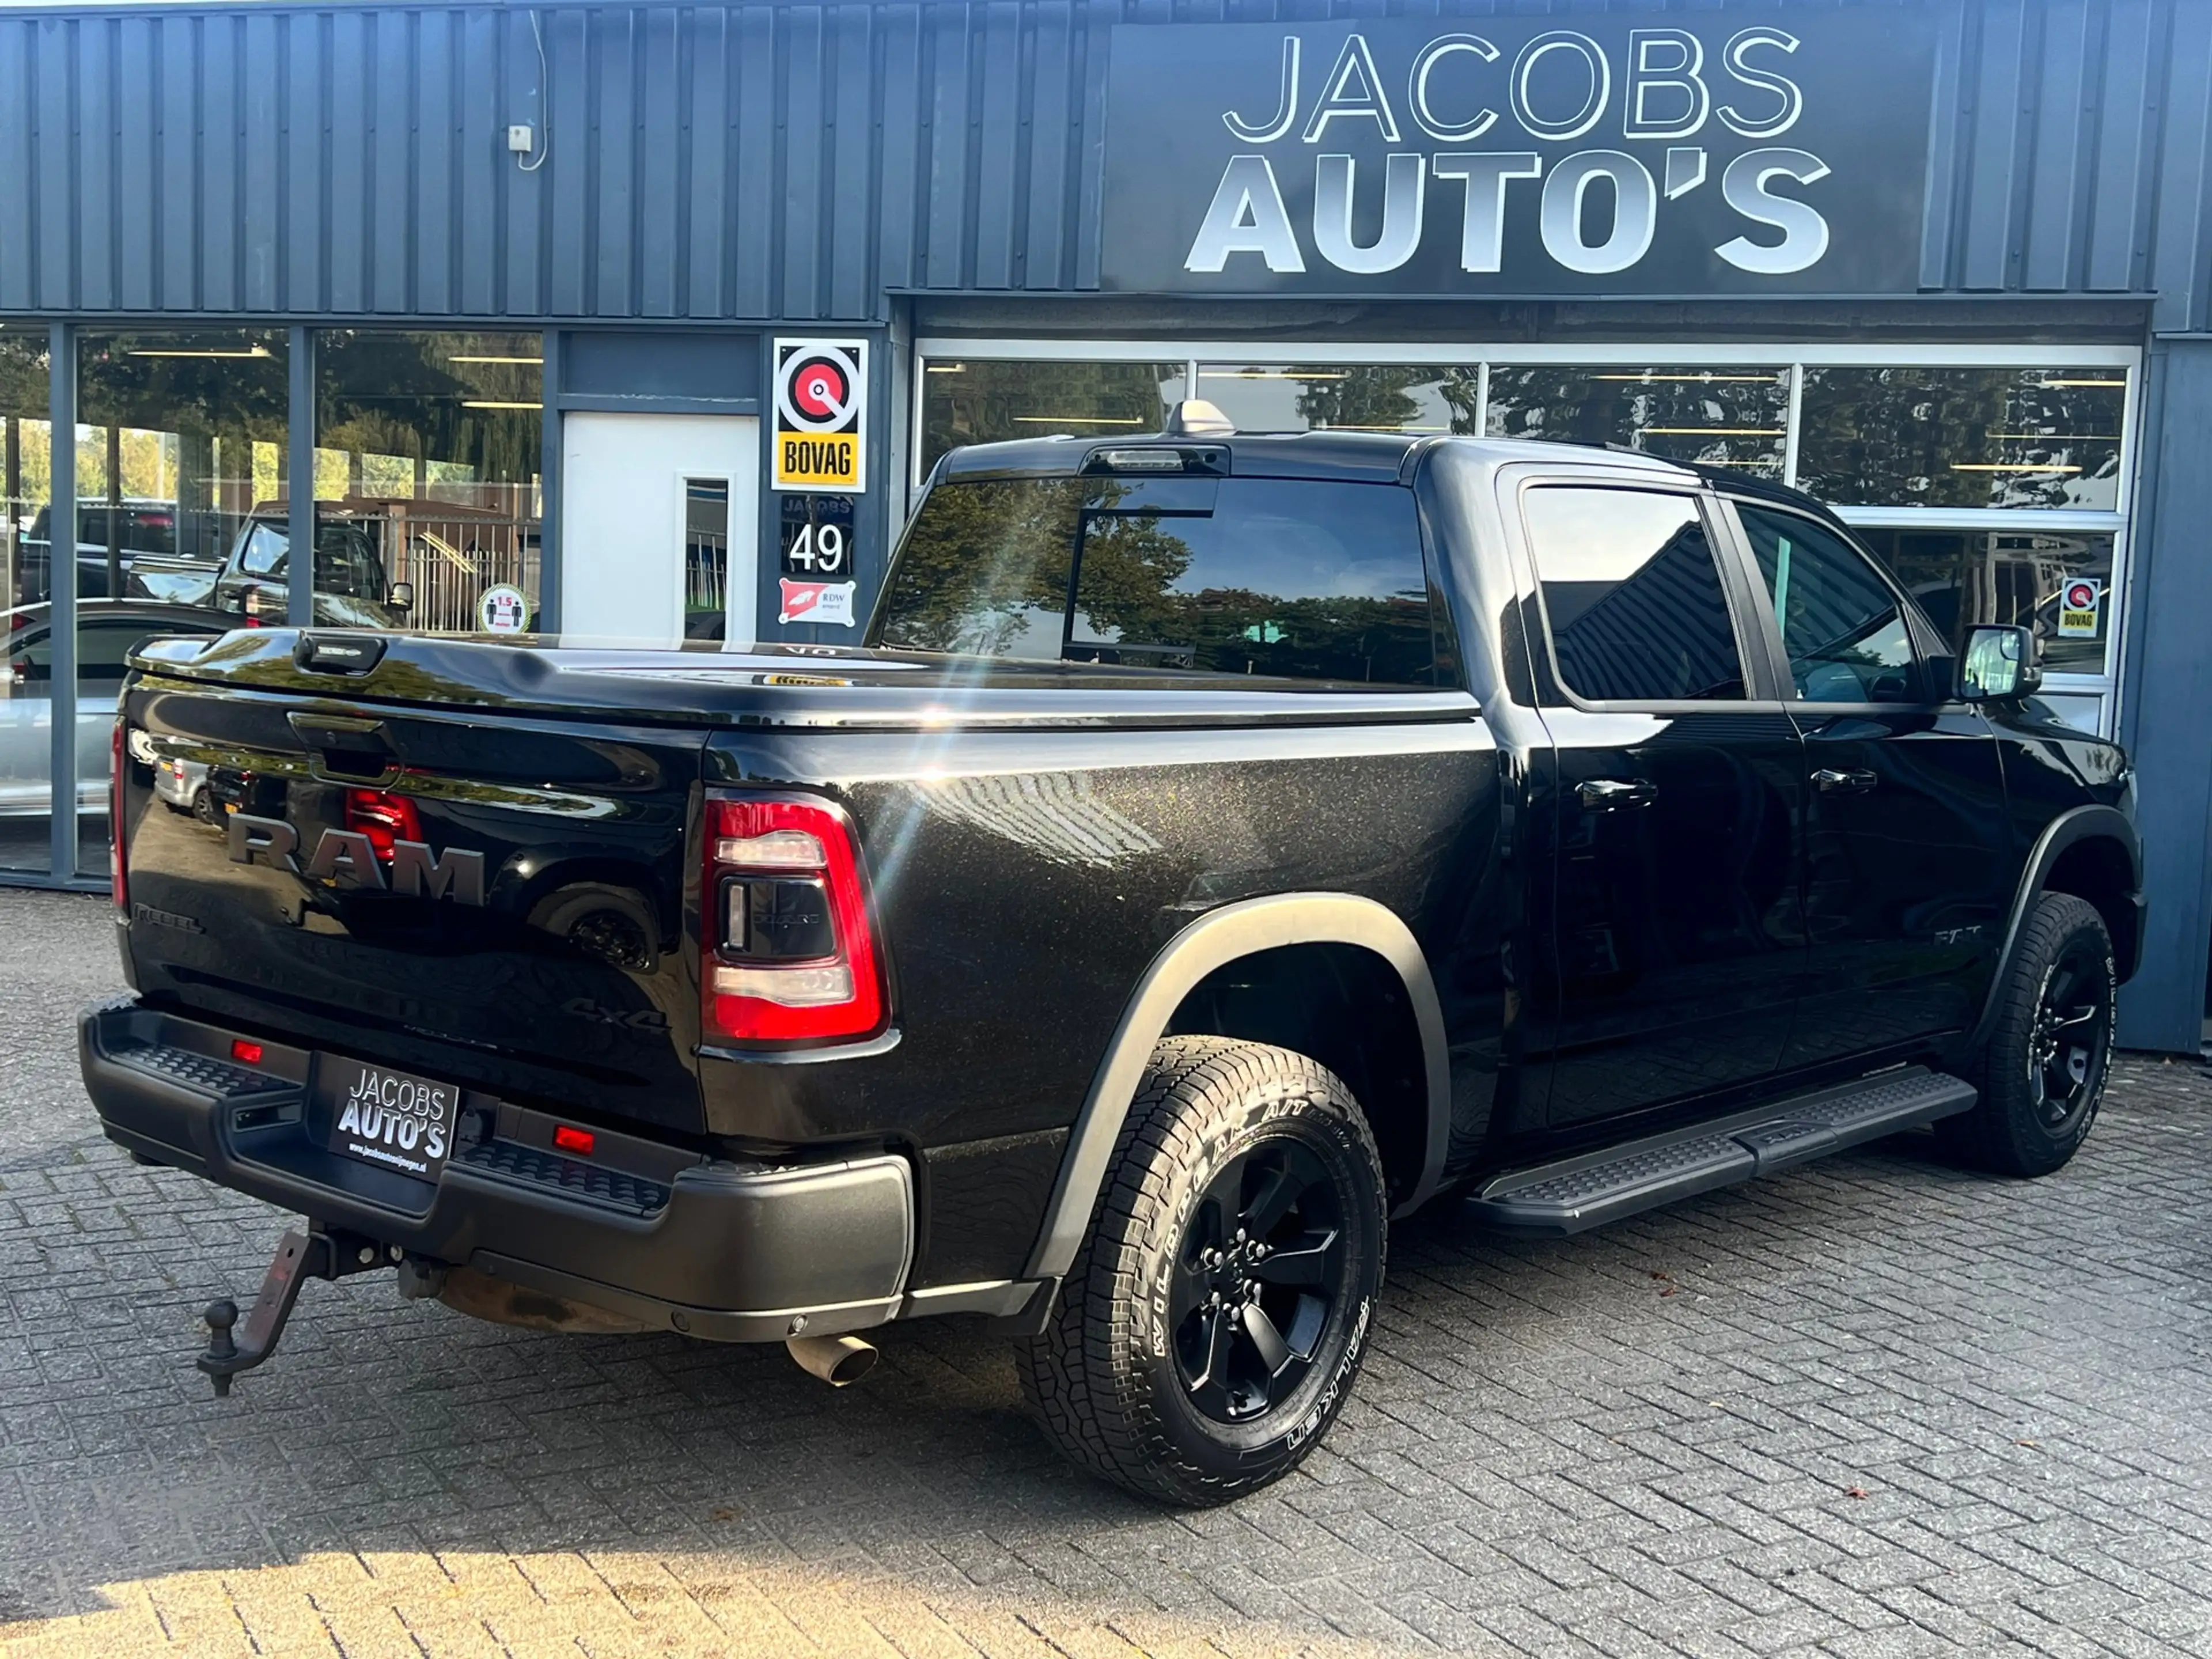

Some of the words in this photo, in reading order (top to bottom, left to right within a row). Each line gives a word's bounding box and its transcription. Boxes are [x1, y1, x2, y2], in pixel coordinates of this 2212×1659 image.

[1222, 26, 1803, 143] JACOBS
[1184, 147, 1831, 274] AUTO'S
[785, 441, 851, 475] BOVAG
[789, 523, 843, 571] 49
[498, 597, 512, 606] 1.5
[822, 593, 845, 602] RDW
[2065, 613, 2093, 626] BOVAG
[230, 813, 486, 907] RAM
[349, 1069, 445, 1120] JACOBS
[338, 1099, 446, 1158] AUTO'S
